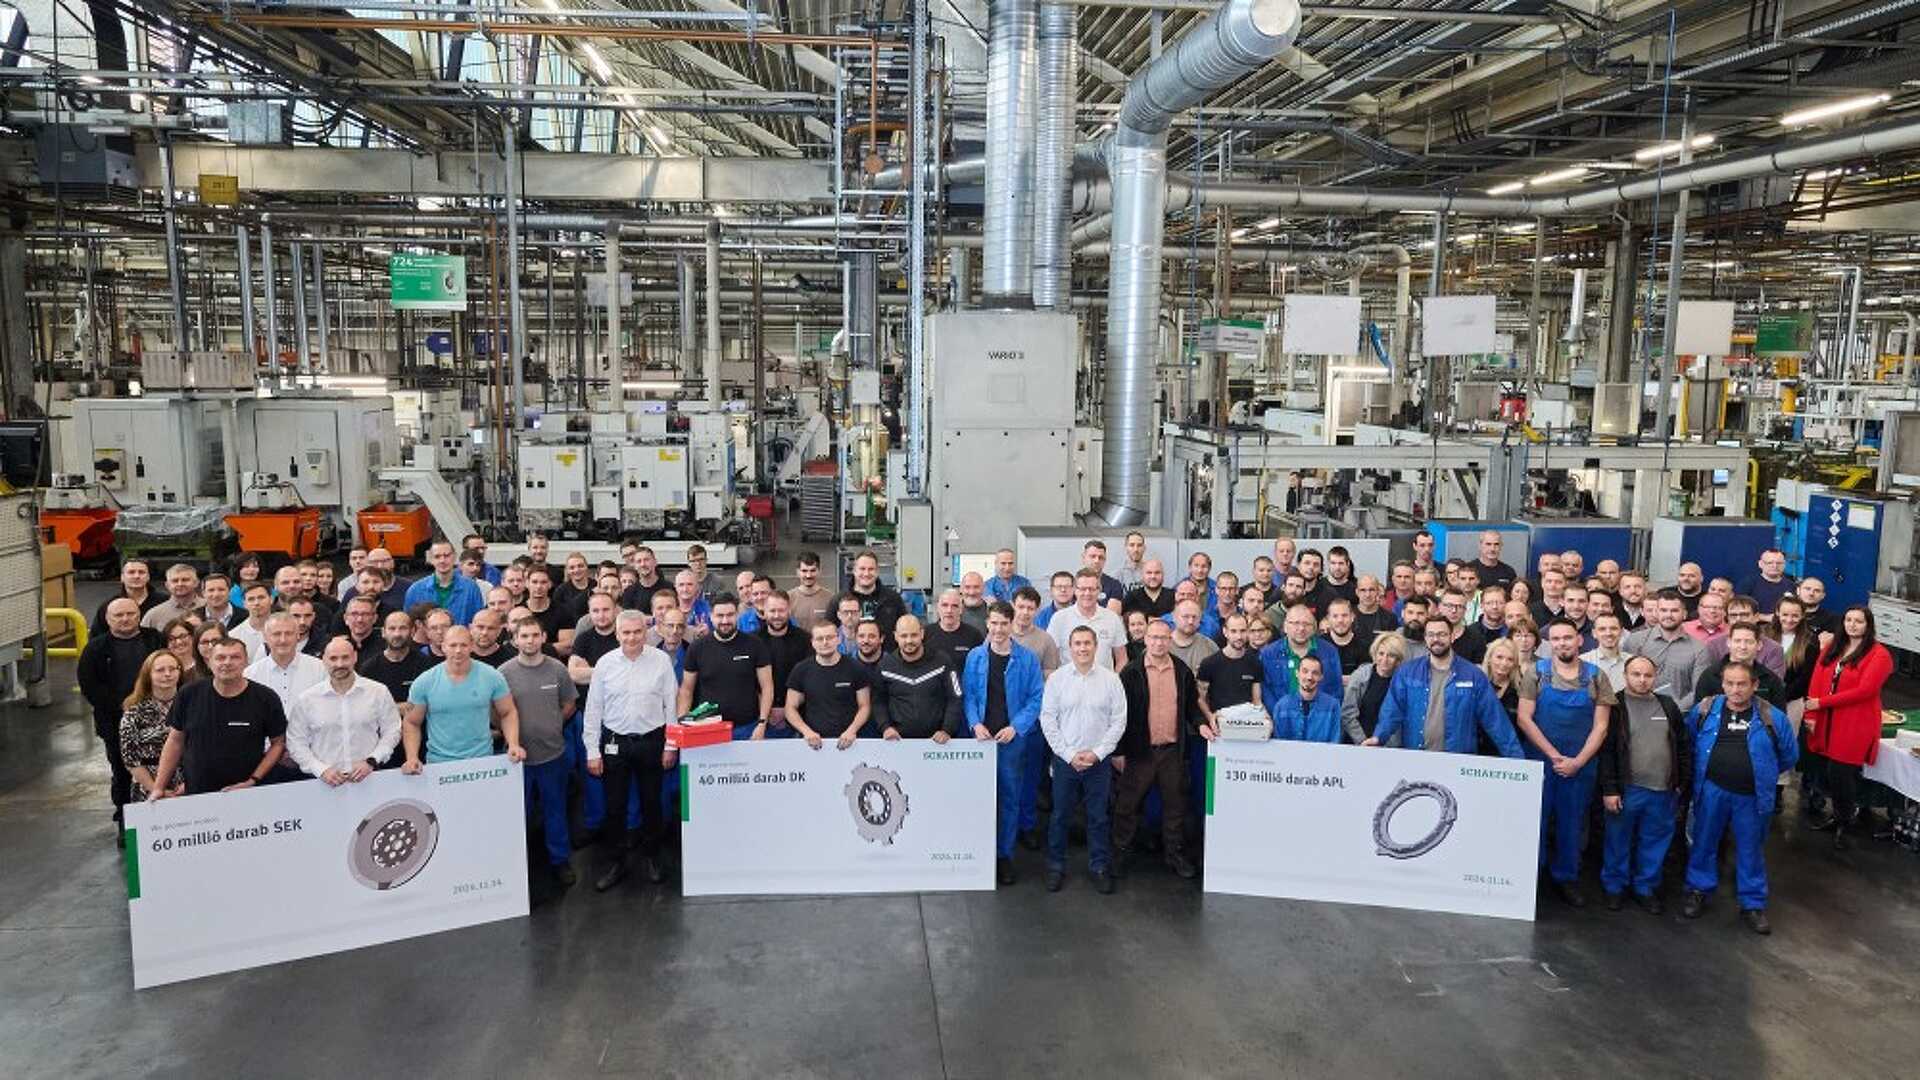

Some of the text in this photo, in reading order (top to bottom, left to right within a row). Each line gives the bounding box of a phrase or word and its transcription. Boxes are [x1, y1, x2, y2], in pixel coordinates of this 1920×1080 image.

[988, 350, 1016, 361] VARIO
[924, 751, 984, 760] SCHAEFFLER
[439, 768, 508, 785] SCHAEFFLER
[698, 771, 806, 785] 40 millió darab DK
[1226, 770, 1345, 789] 130 millió darab APL
[1460, 767, 1529, 782] SCHAEFFLER
[152, 818, 302, 852] 60 millió darab SEK
